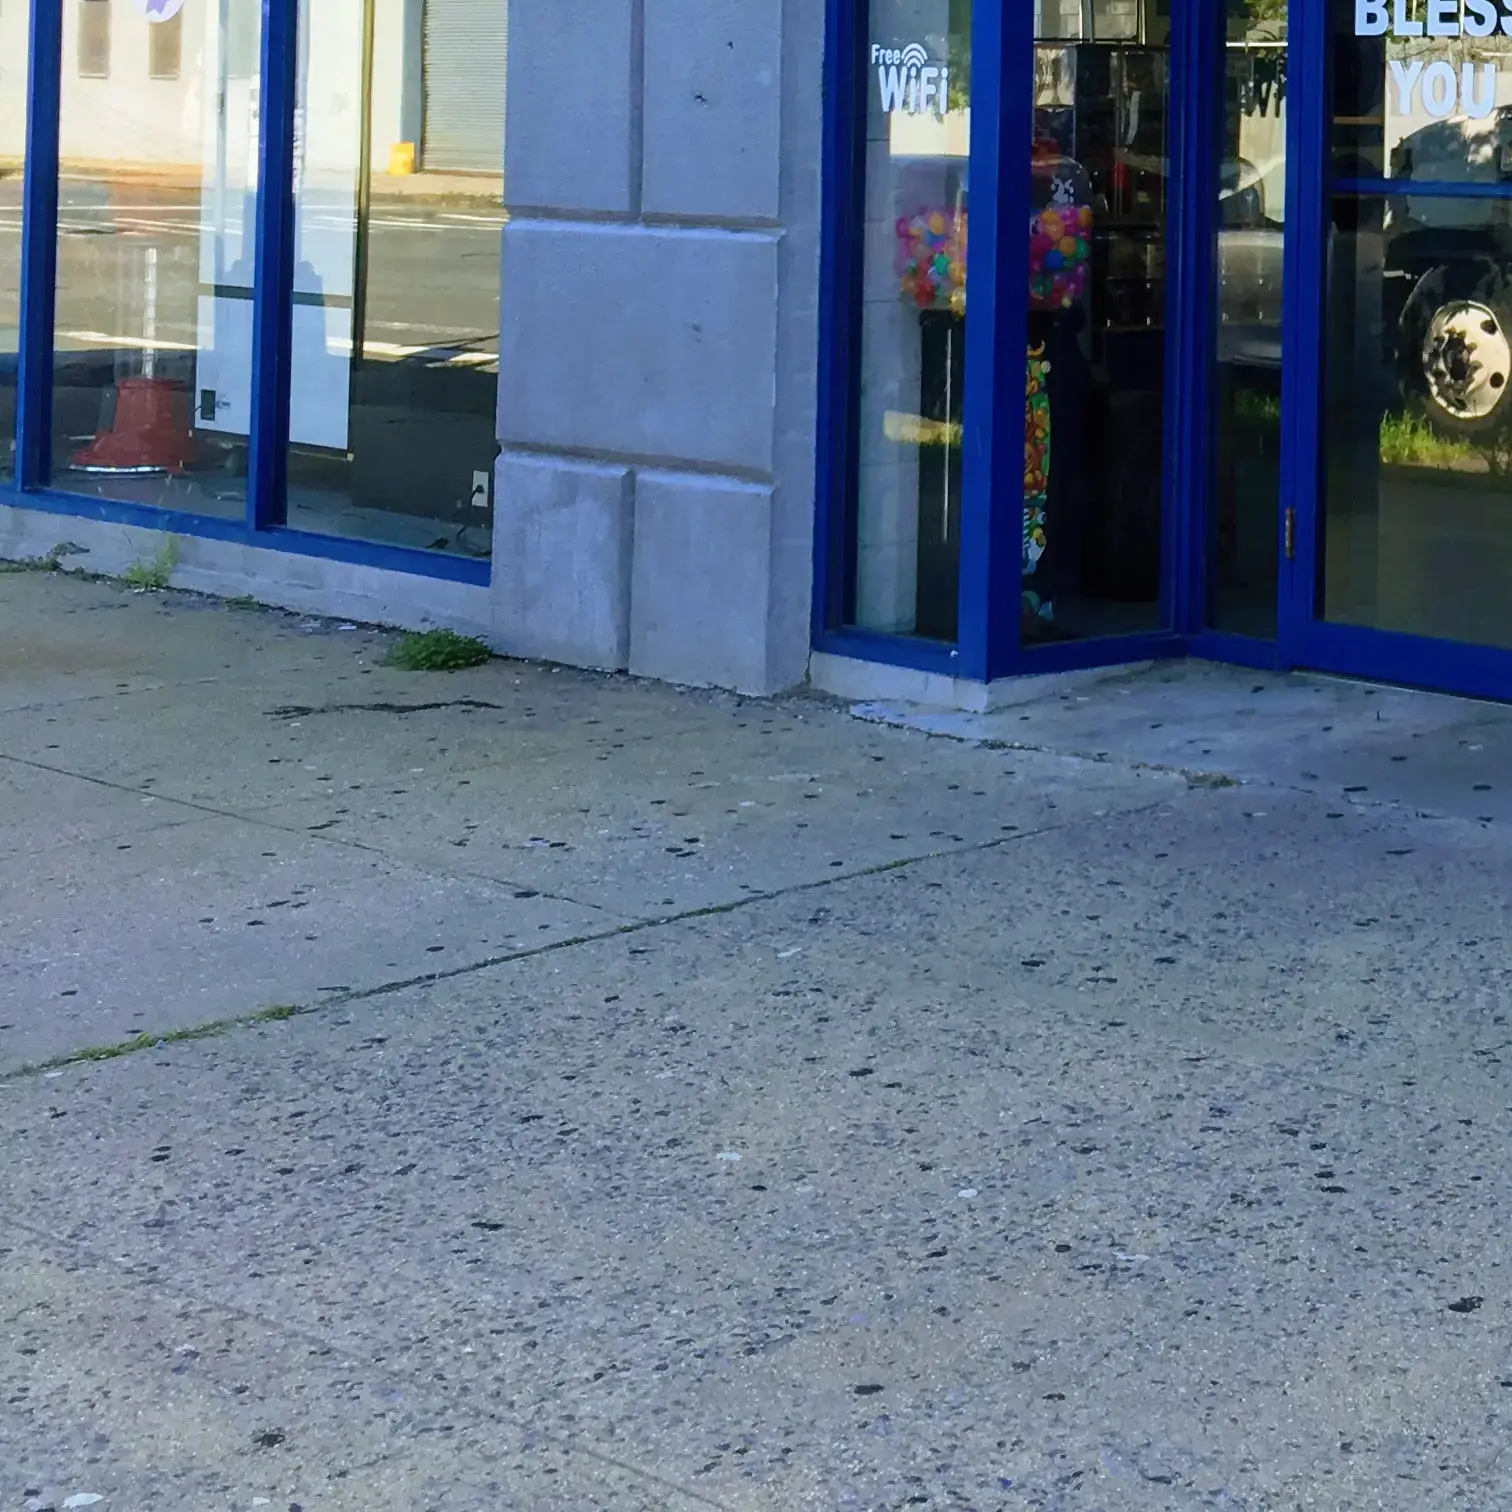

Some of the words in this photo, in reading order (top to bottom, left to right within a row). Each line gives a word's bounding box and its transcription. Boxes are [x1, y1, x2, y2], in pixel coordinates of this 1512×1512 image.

[871, 43, 901, 65] Free
[879, 65, 948, 115] WiFi
[1389, 60, 1496, 119] YOU
